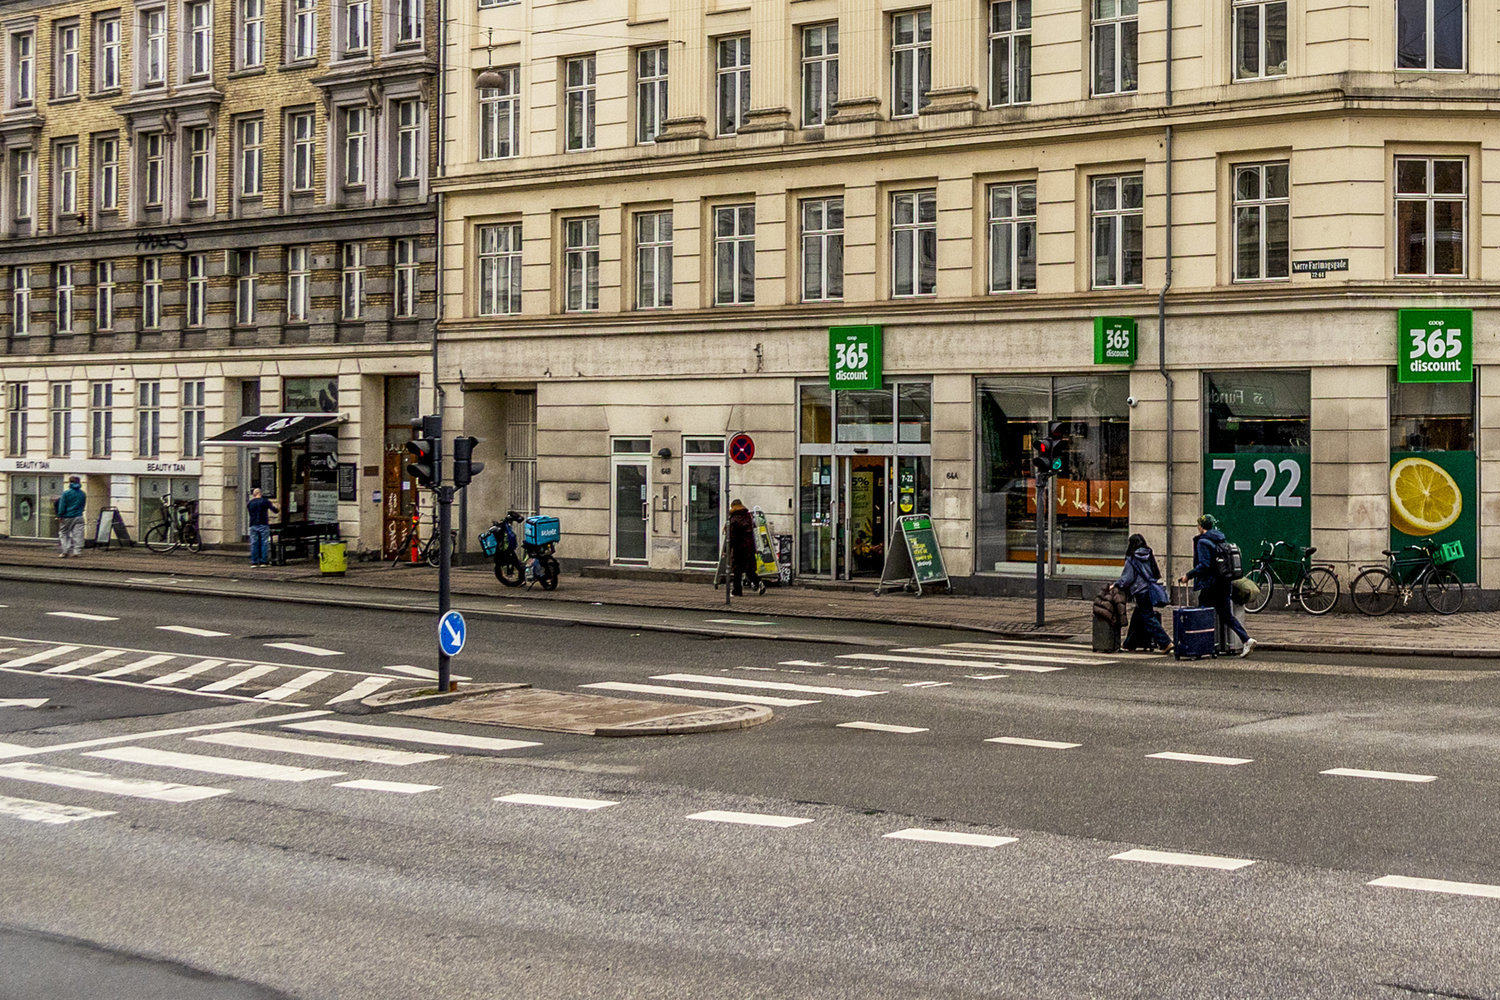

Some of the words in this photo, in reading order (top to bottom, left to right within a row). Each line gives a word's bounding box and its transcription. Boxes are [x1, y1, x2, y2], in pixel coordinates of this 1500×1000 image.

[1106, 329, 1129, 349] 365
[1409, 328, 1462, 359] 365
[835, 343, 868, 369] 365
[1106, 349, 1129, 358] discount
[1410, 359, 1461, 372] discount
[835, 370, 868, 381] discount
[16, 461, 38, 469] BEAUTY
[39, 461, 49, 469] TAN
[147, 463, 172, 472] BEAUTY
[173, 463, 186, 472] TAN
[901, 474, 914, 482] 7-22
[946, 472, 959, 480] 64A
[1212, 459, 1302, 507] 7-22
